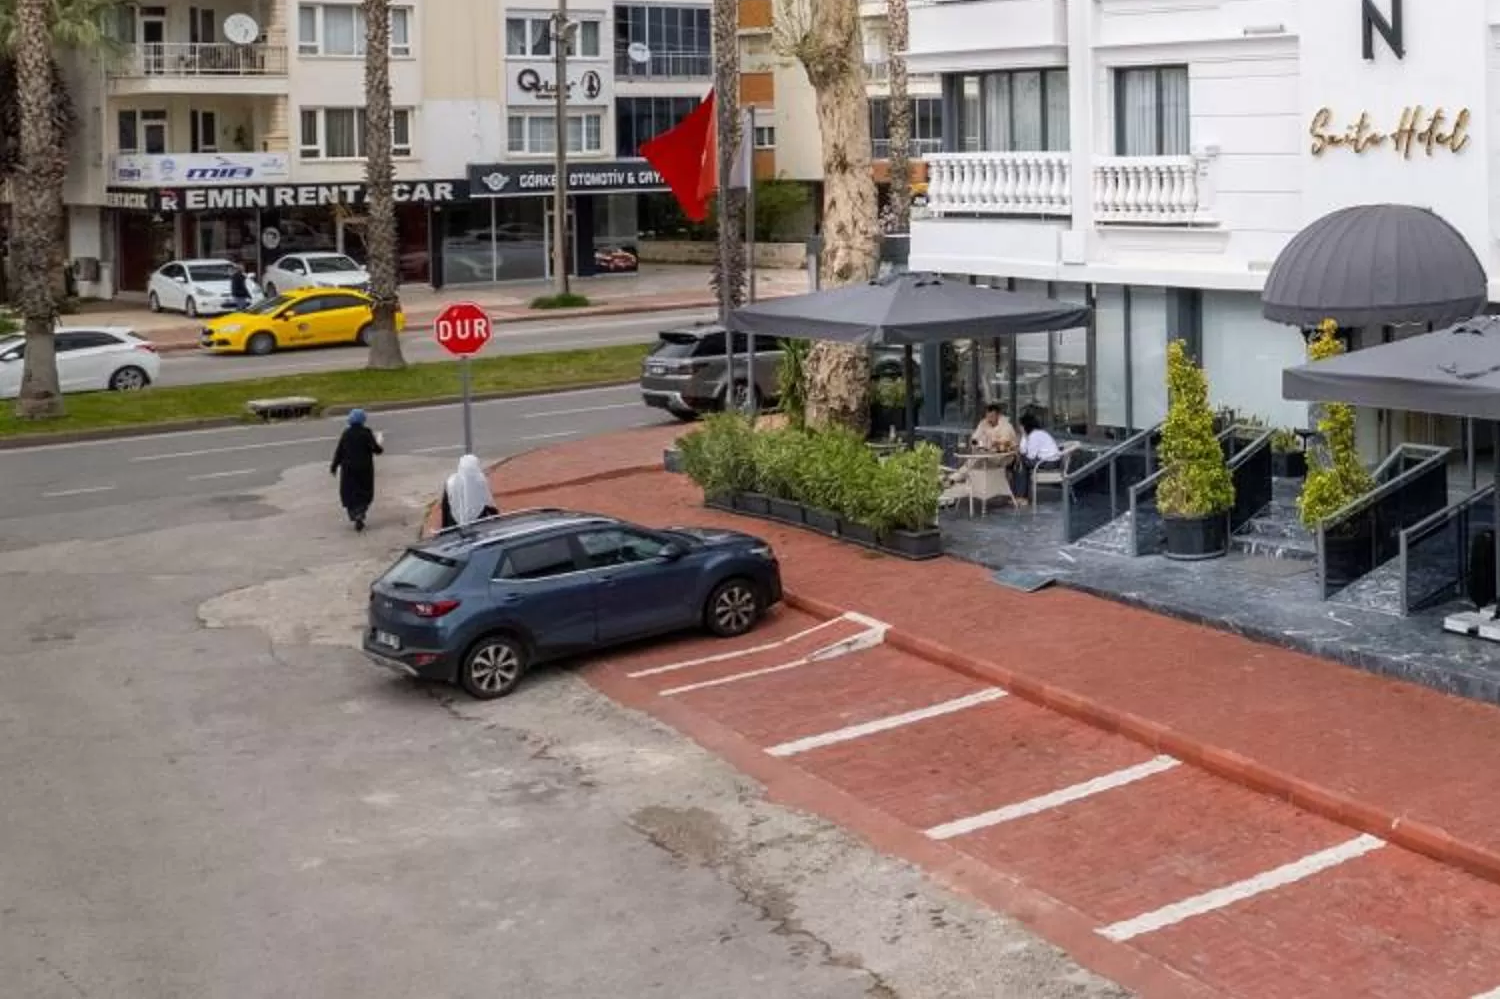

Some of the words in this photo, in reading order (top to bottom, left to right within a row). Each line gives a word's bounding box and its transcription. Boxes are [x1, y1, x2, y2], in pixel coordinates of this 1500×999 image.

[1309, 107, 1388, 156] Suite
[1390, 104, 1471, 160] Hotel
[273, 184, 361, 206] RENT
[392, 182, 454, 202] CAR
[439, 318, 488, 341] DUR
